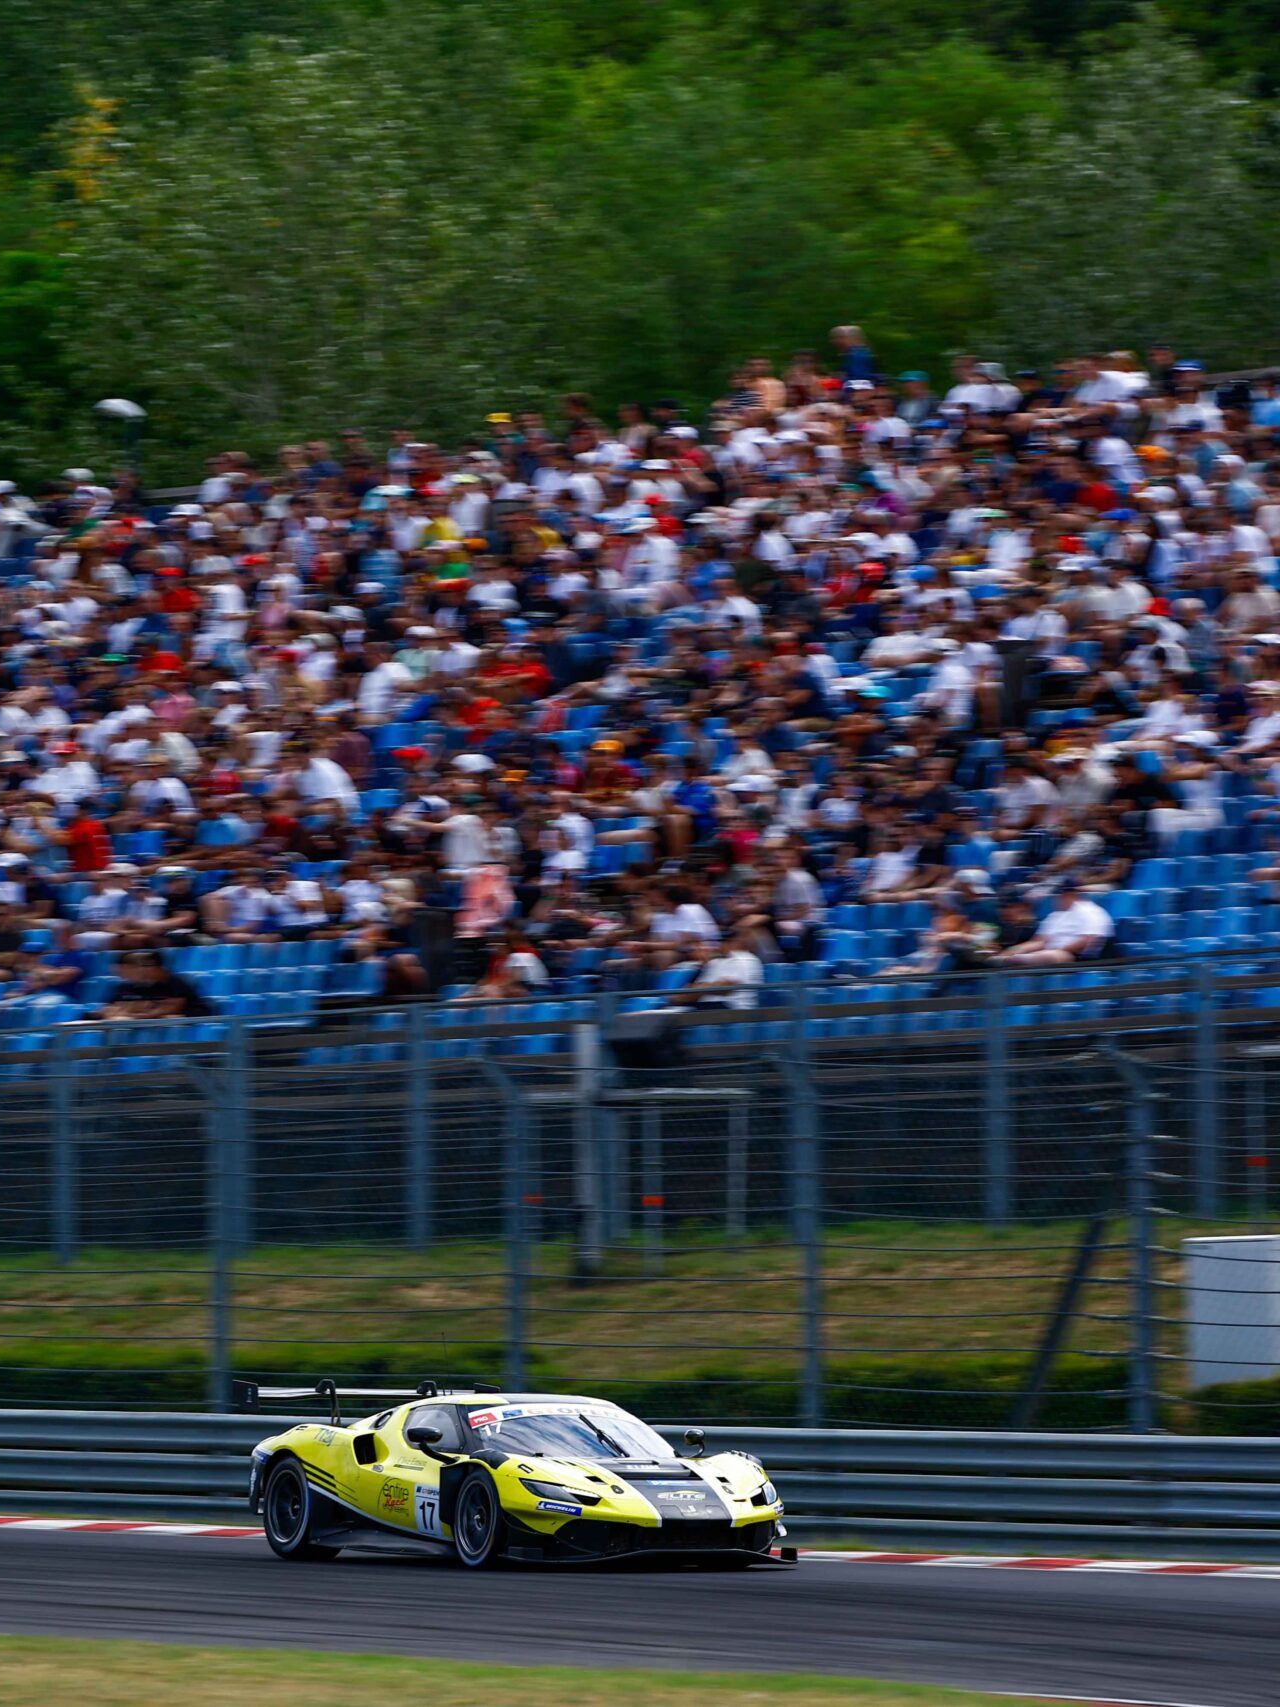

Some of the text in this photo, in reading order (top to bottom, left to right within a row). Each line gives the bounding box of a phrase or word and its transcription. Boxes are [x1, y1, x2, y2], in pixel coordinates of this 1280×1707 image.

[473, 1416, 489, 1424] PRO
[480, 1422, 503, 1437] 17
[545, 1503, 577, 1513] MICHELIN
[419, 1500, 435, 1531] 17
